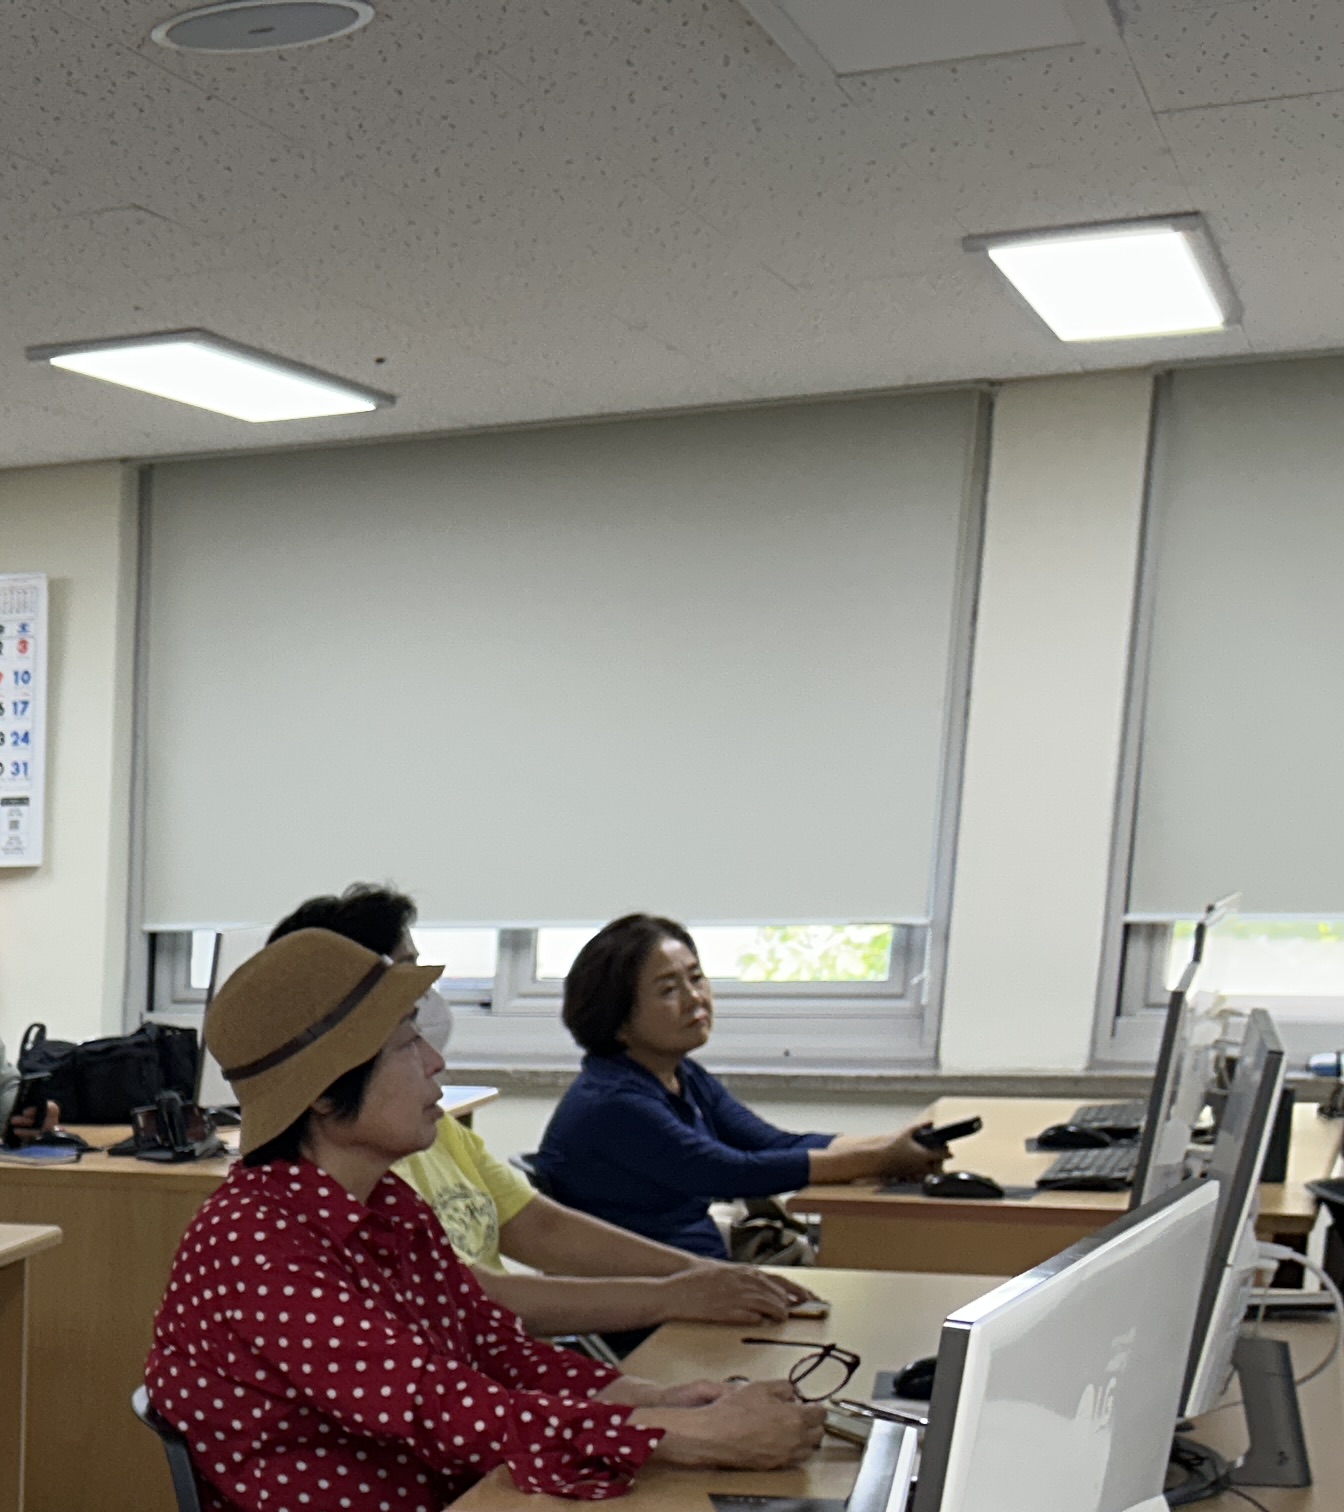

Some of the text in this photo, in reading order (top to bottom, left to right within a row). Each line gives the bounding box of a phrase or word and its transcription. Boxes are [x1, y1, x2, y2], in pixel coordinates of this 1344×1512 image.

[18, 639, 29, 654] 3
[14, 671, 31, 684] 10
[13, 701, 29, 715] 17
[11, 731, 30, 745] 24
[11, 762, 28, 776] 31
